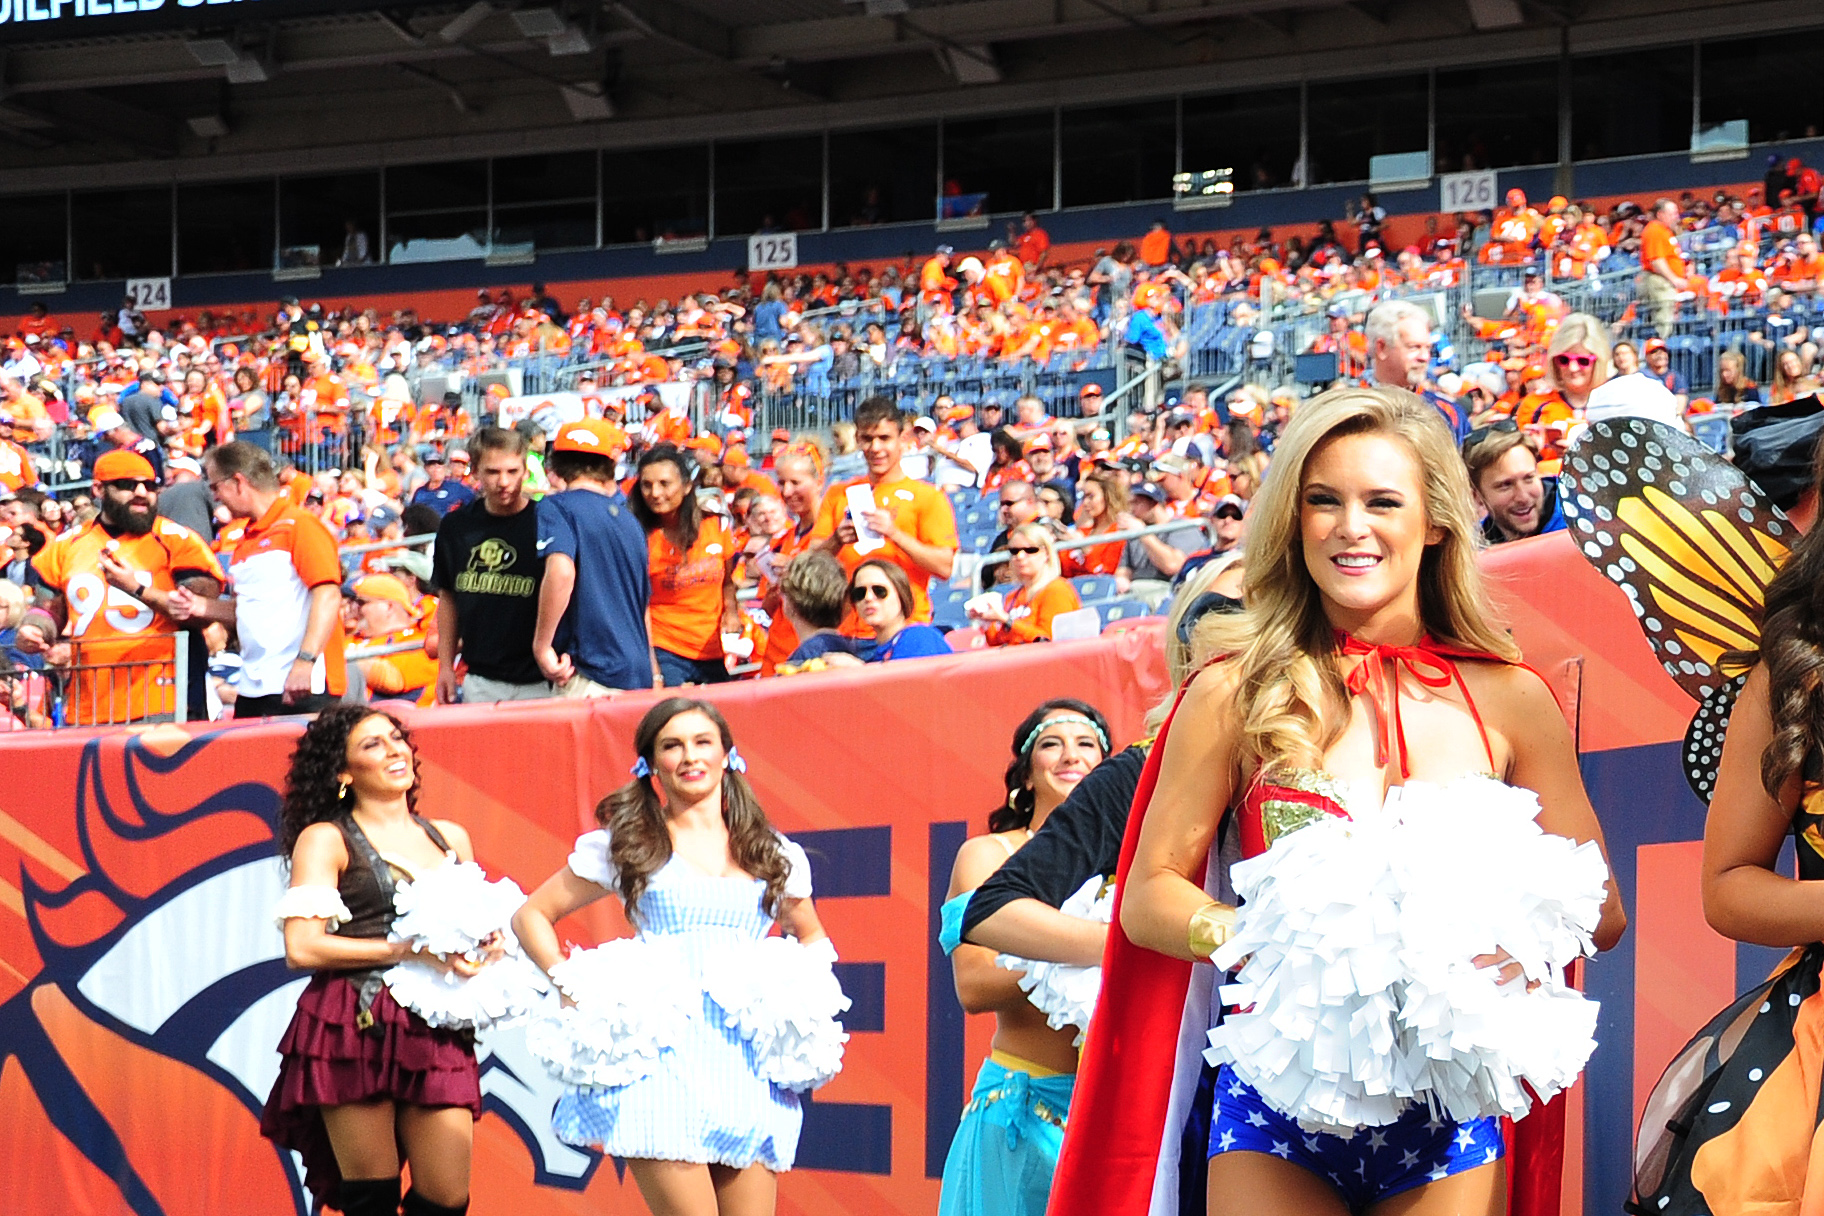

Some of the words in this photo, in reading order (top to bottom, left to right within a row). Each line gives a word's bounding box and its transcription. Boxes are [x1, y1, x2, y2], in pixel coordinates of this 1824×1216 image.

[1447, 177, 1490, 205] 126
[755, 239, 792, 265] 125
[131, 282, 167, 305] 124
[455, 571, 536, 598] COLORADO
[66, 570, 156, 637] 95
